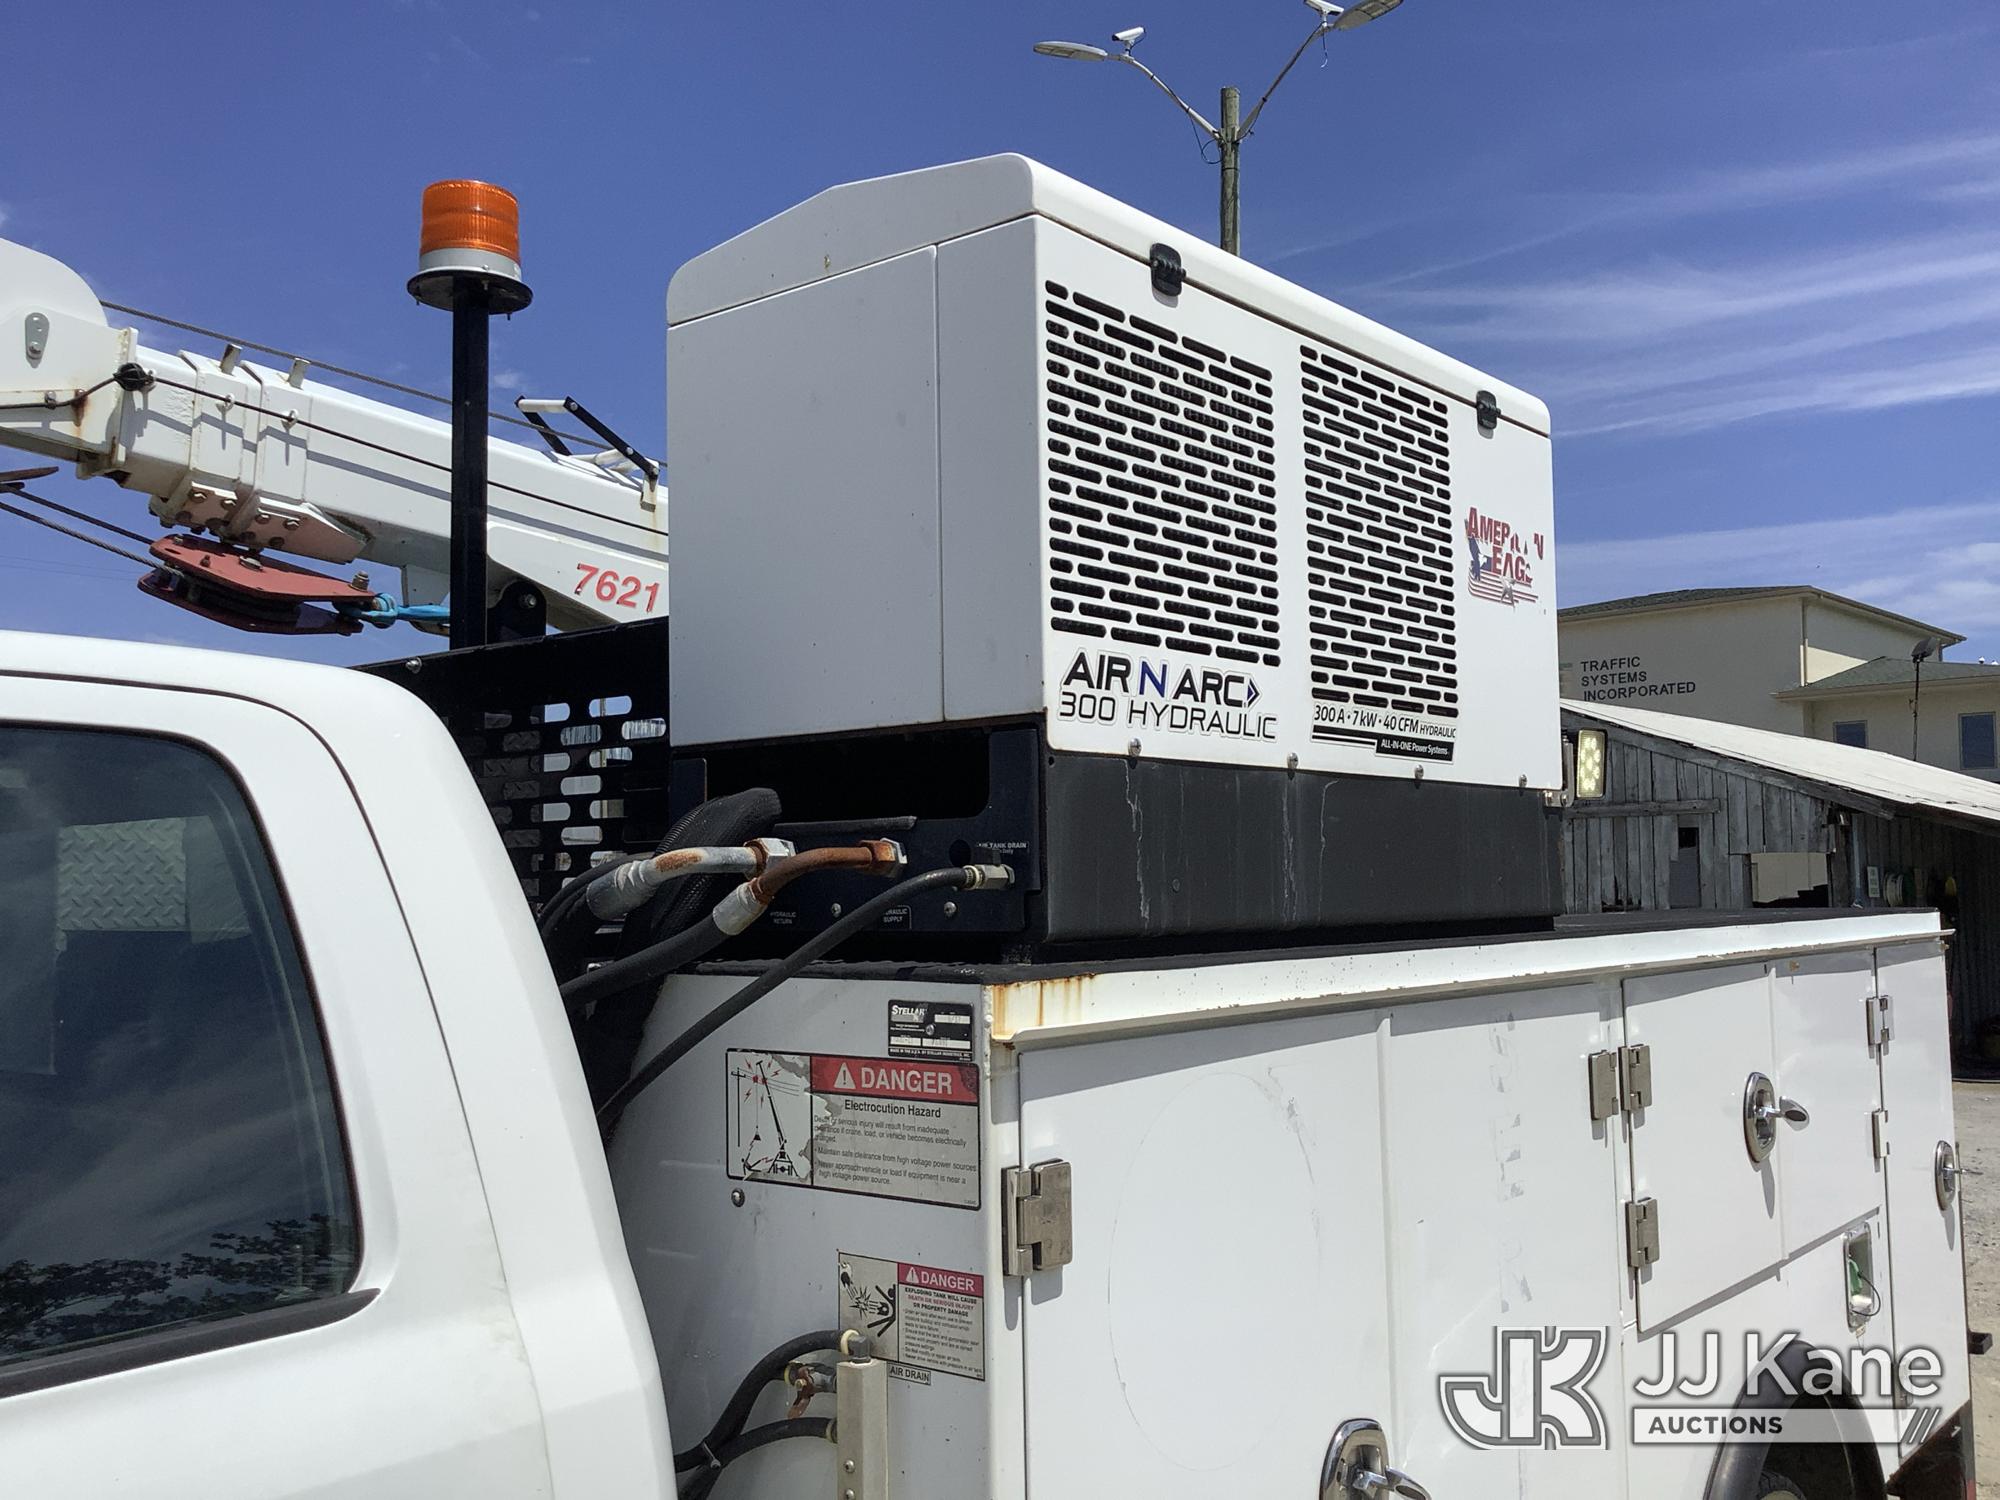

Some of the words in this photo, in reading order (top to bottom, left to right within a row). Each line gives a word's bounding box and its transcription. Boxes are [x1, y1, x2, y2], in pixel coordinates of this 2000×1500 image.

[574, 563, 660, 613] 7621
[1580, 656, 1640, 672] TRAFFIC
[1063, 652, 1131, 693] AIR
[1138, 661, 1167, 698] N
[1172, 668, 1245, 708] ARC
[1581, 672, 1647, 686] SYSTEMS
[1584, 682, 1696, 701] INCORPORATED
[1060, 691, 1116, 721] 300
[1128, 700, 1277, 740] HYDRAULIC
[1384, 716, 1396, 730] 40
[1398, 717, 1418, 734] CFM
[1420, 724, 1456, 738] HYDRAULIC
[1381, 739, 1412, 751] ALL-IN-ONE
[1412, 744, 1428, 754] Power
[892, 1004, 924, 1016] STELLAR
[861, 1067, 953, 1095] DANGER
[844, 1100, 905, 1115] Electrocution
[908, 1105, 941, 1118] Hazard
[859, 1119, 874, 1129] injury
[902, 1123, 915, 1131] from
[917, 1126, 950, 1136] inadequate
[907, 1134, 934, 1144] becomes
[935, 1137, 967, 1148] electrically
[882, 1153, 895, 1162] from
[897, 1155, 910, 1166] high
[910, 1157, 932, 1168] voltage
[933, 1160, 951, 1170] power
[921, 1272, 975, 1292] DANGER
[905, 1287, 932, 1296] EXPLODING
[948, 1294, 959, 1302] WILL
[921, 1303, 946, 1313] PROPERTY
[948, 1308, 968, 1317] DAMAGE
[890, 1366, 904, 1377] AIR
[905, 1368, 930, 1381] DRAIN
